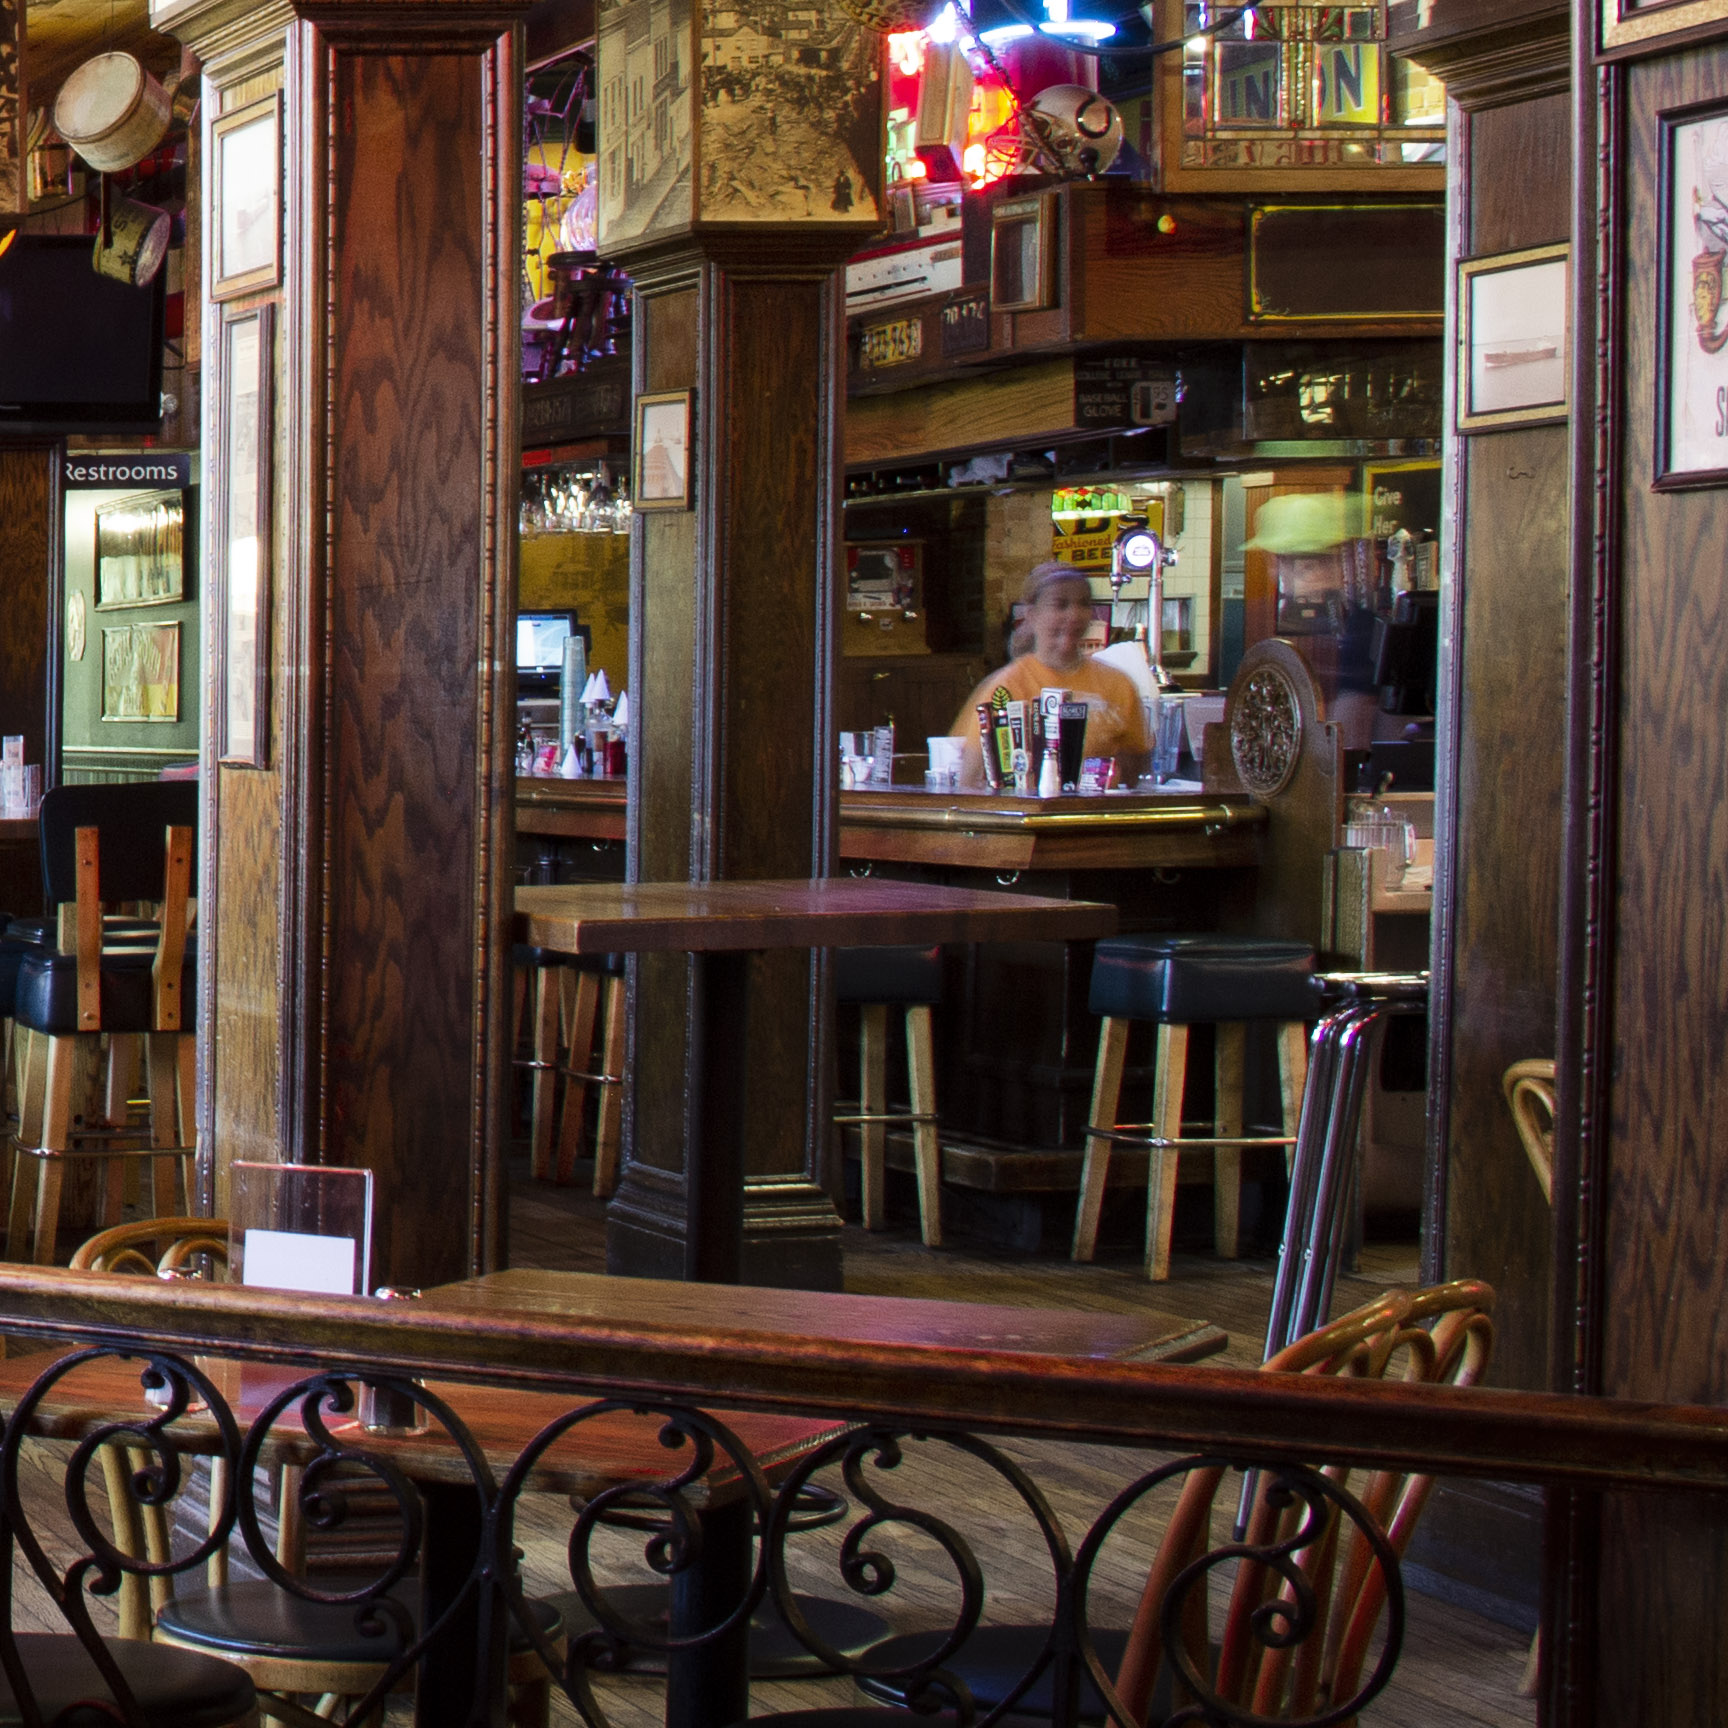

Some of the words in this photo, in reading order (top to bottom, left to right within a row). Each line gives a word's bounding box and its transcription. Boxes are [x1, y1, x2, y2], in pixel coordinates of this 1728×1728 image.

[1079, 393, 1128, 403] BASEBALL
[1084, 404, 1122, 418] GLOVE
[66, 462, 178, 482] Restrooms
[1374, 486, 1402, 505] Give
